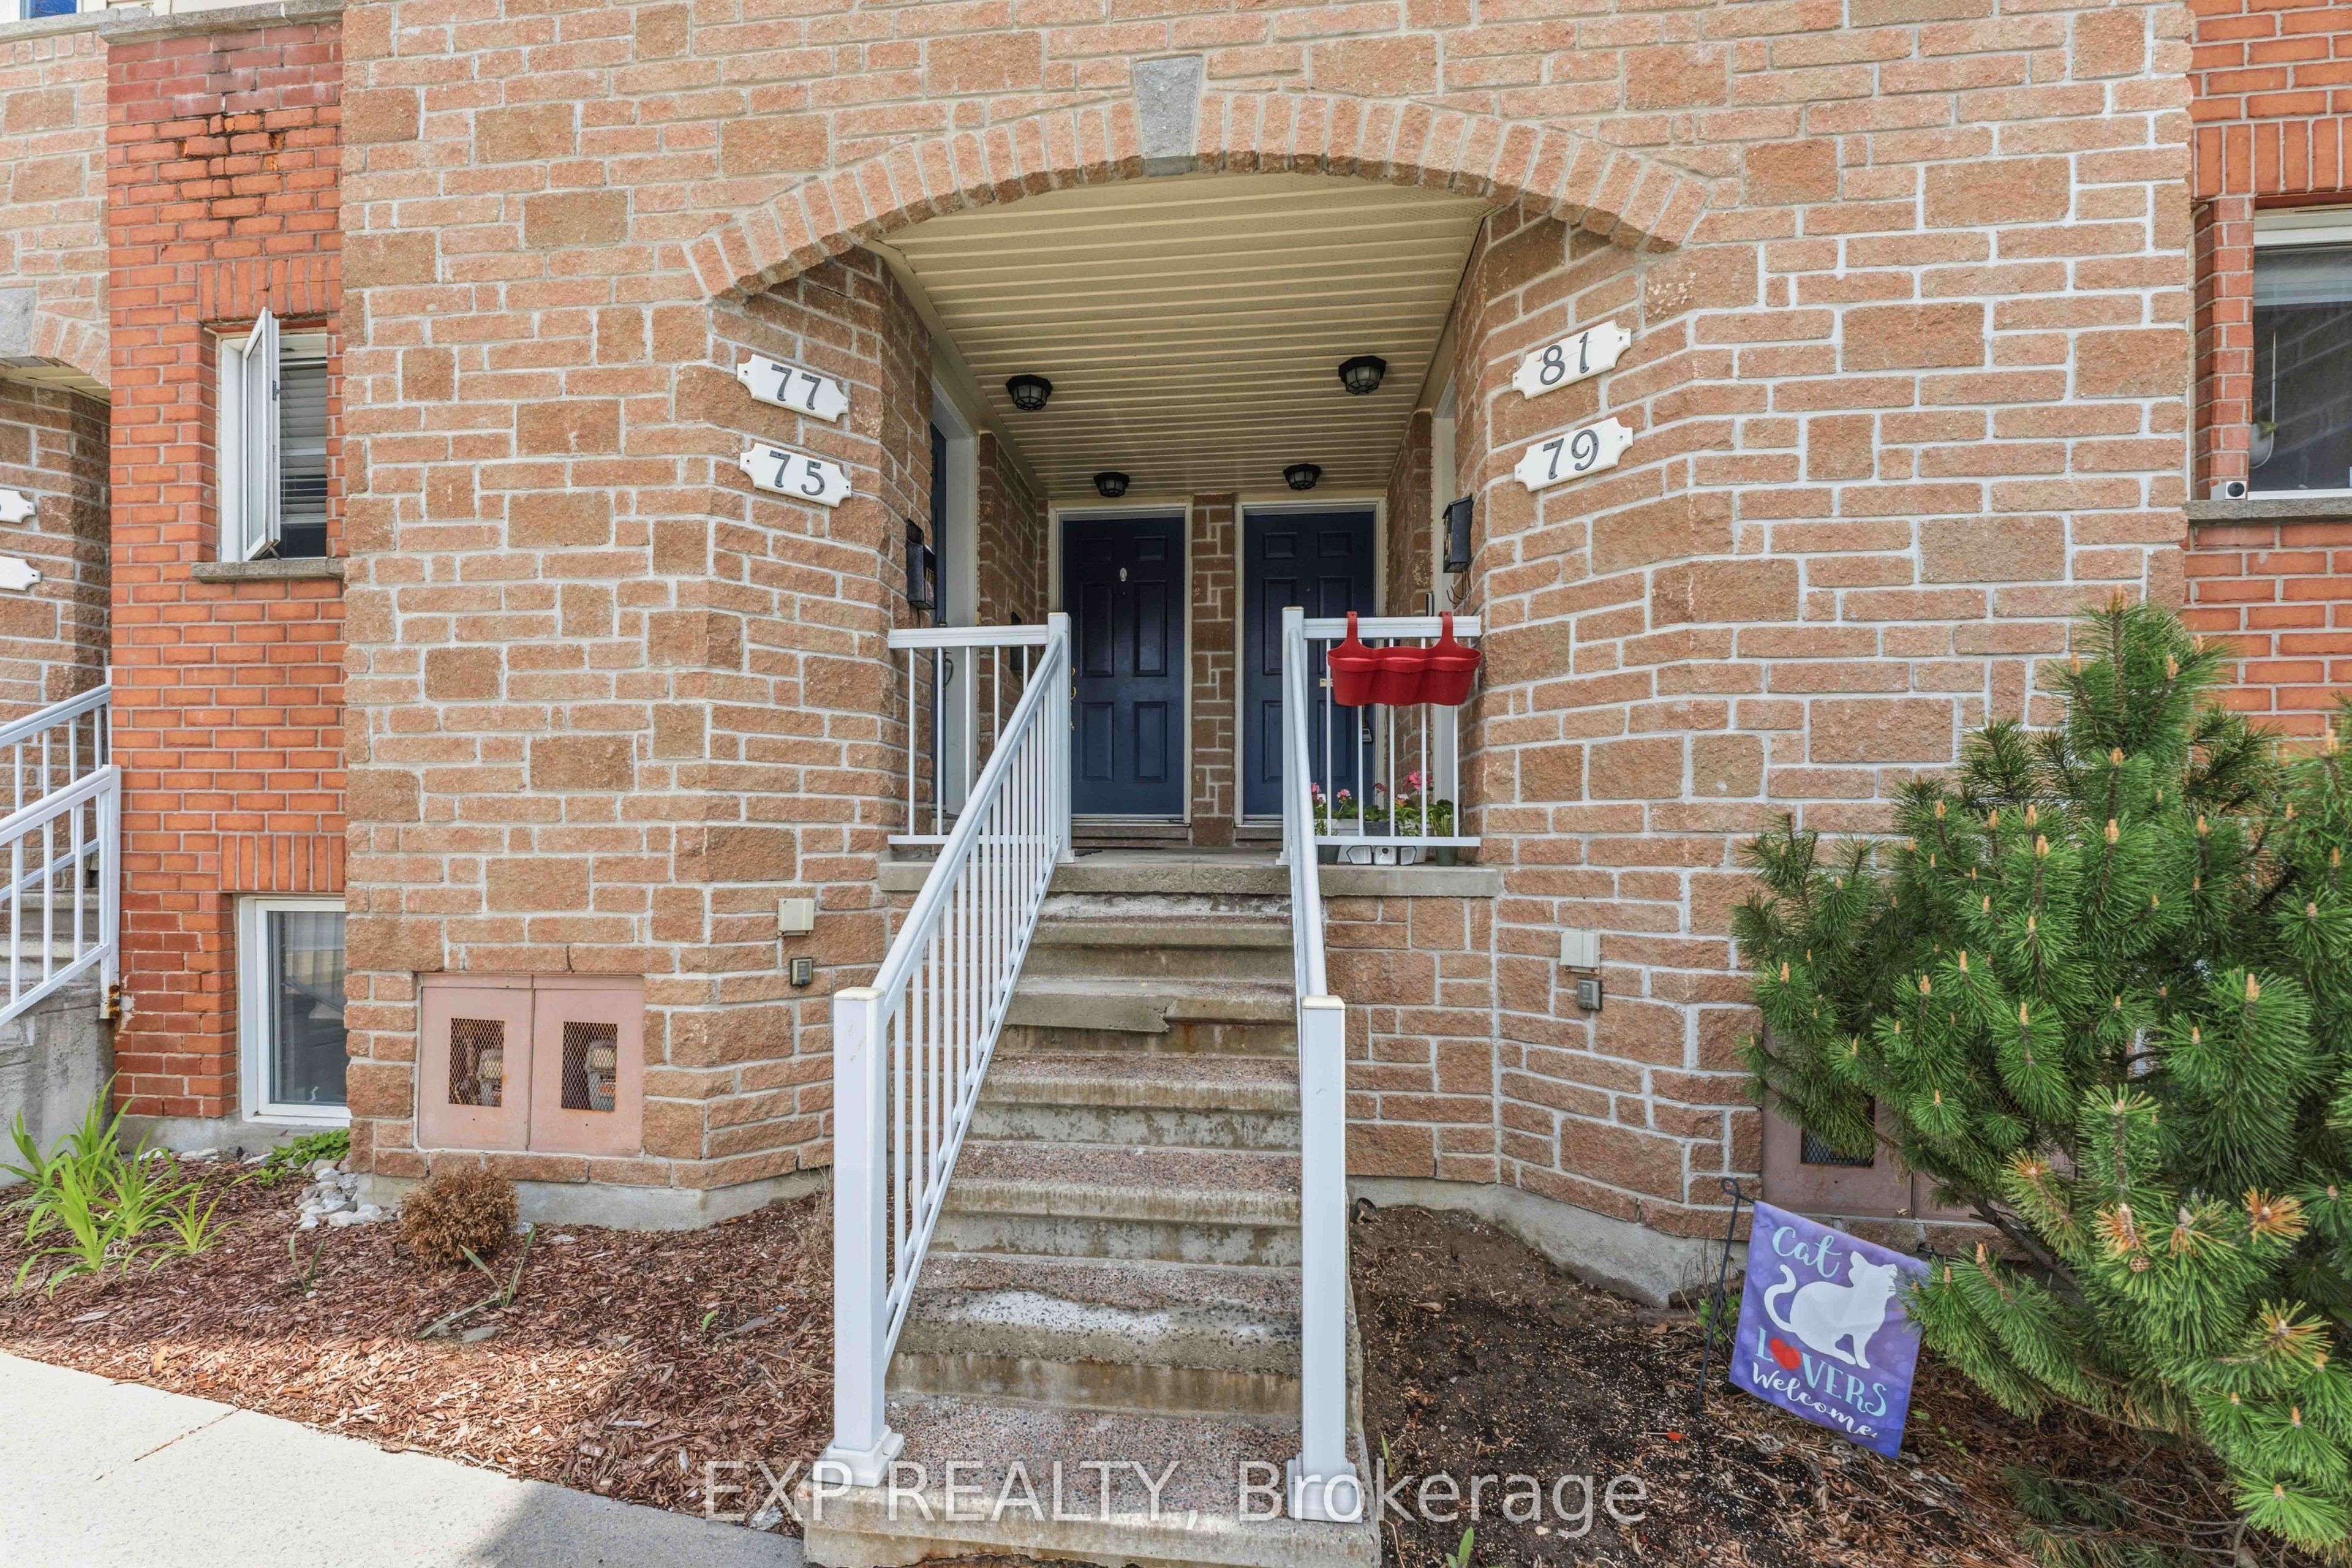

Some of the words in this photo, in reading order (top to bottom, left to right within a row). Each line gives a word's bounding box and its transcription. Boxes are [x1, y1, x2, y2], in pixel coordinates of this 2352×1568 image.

[1540, 332, 1589, 385] 81
[771, 364, 821, 410] 77
[769, 450, 825, 496] 75
[1542, 429, 1599, 480] 79
[1771, 1226, 1842, 1278] Cat
[1753, 1362, 1878, 1438] Welcome
